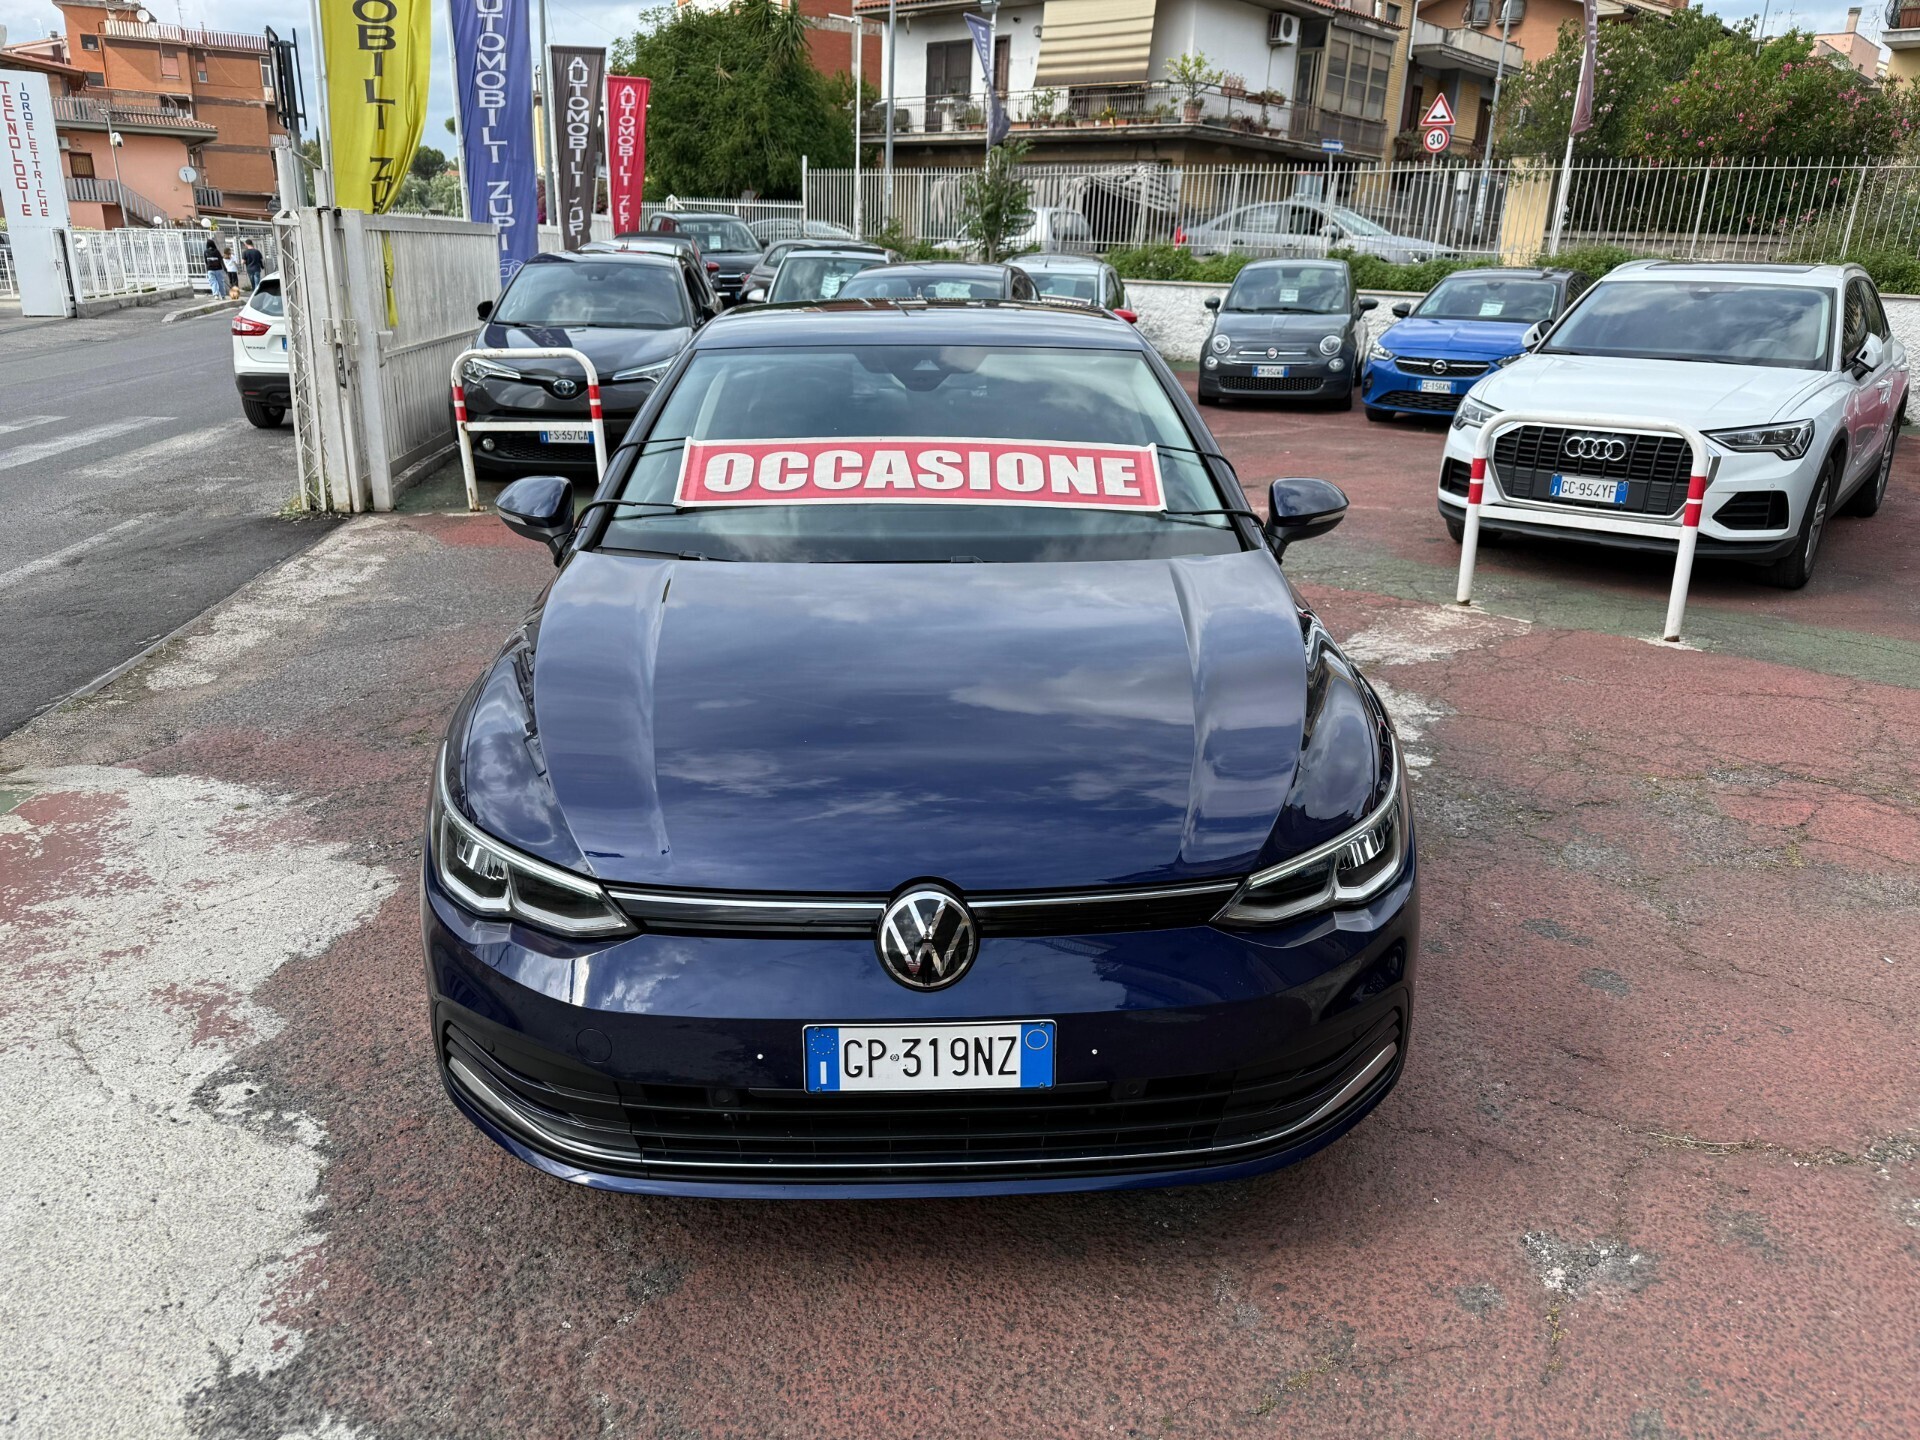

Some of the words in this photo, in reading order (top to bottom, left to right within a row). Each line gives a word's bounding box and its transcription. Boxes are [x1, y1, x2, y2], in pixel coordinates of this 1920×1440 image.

[352, 0, 398, 130] OBILI
[566, 56, 590, 188] AUTOMOBILI
[0, 80, 32, 217] TECNOLOGIE
[19, 82, 49, 217] IDROELETTRICHE
[617, 85, 637, 187] AUTOMOBILI
[1429, 132, 1444, 146] 30
[487, 180, 515, 251] ZUPI
[703, 449, 1142, 497] OCCASIONE
